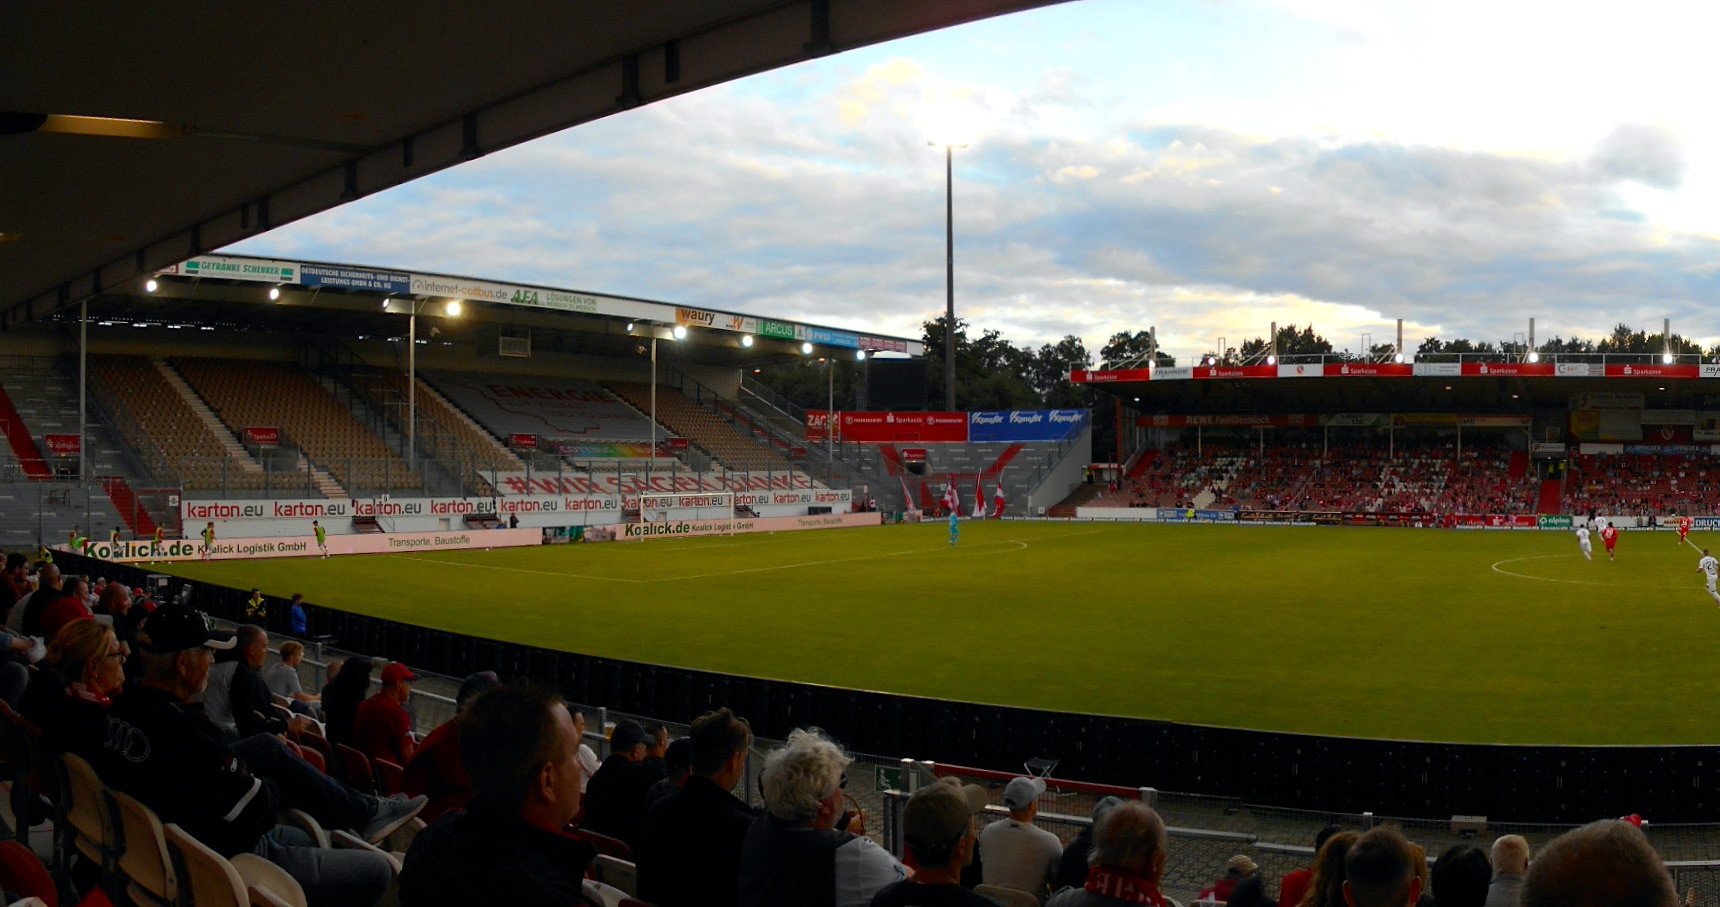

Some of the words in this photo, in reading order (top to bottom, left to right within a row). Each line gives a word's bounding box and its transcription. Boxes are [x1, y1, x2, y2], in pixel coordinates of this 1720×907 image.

[766, 321, 793, 336] ARCUS
[1633, 368, 1662, 376] Sparkasse
[679, 495, 723, 507] karton.eu
[774, 492, 811, 504] karton.eu
[815, 490, 850, 503] karton.eu
[187, 502, 264, 519] karton.eu
[274, 501, 345, 517] karton.eu
[500, 498, 557, 513] karton.eu
[565, 497, 618, 511] karton.eu
[737, 521, 754, 530] GmbH
[1548, 517, 1570, 525] alpina
[237, 542, 275, 555] Logistik
[277, 541, 307, 552] GmbH
[1706, 561, 1715, 570] 21
